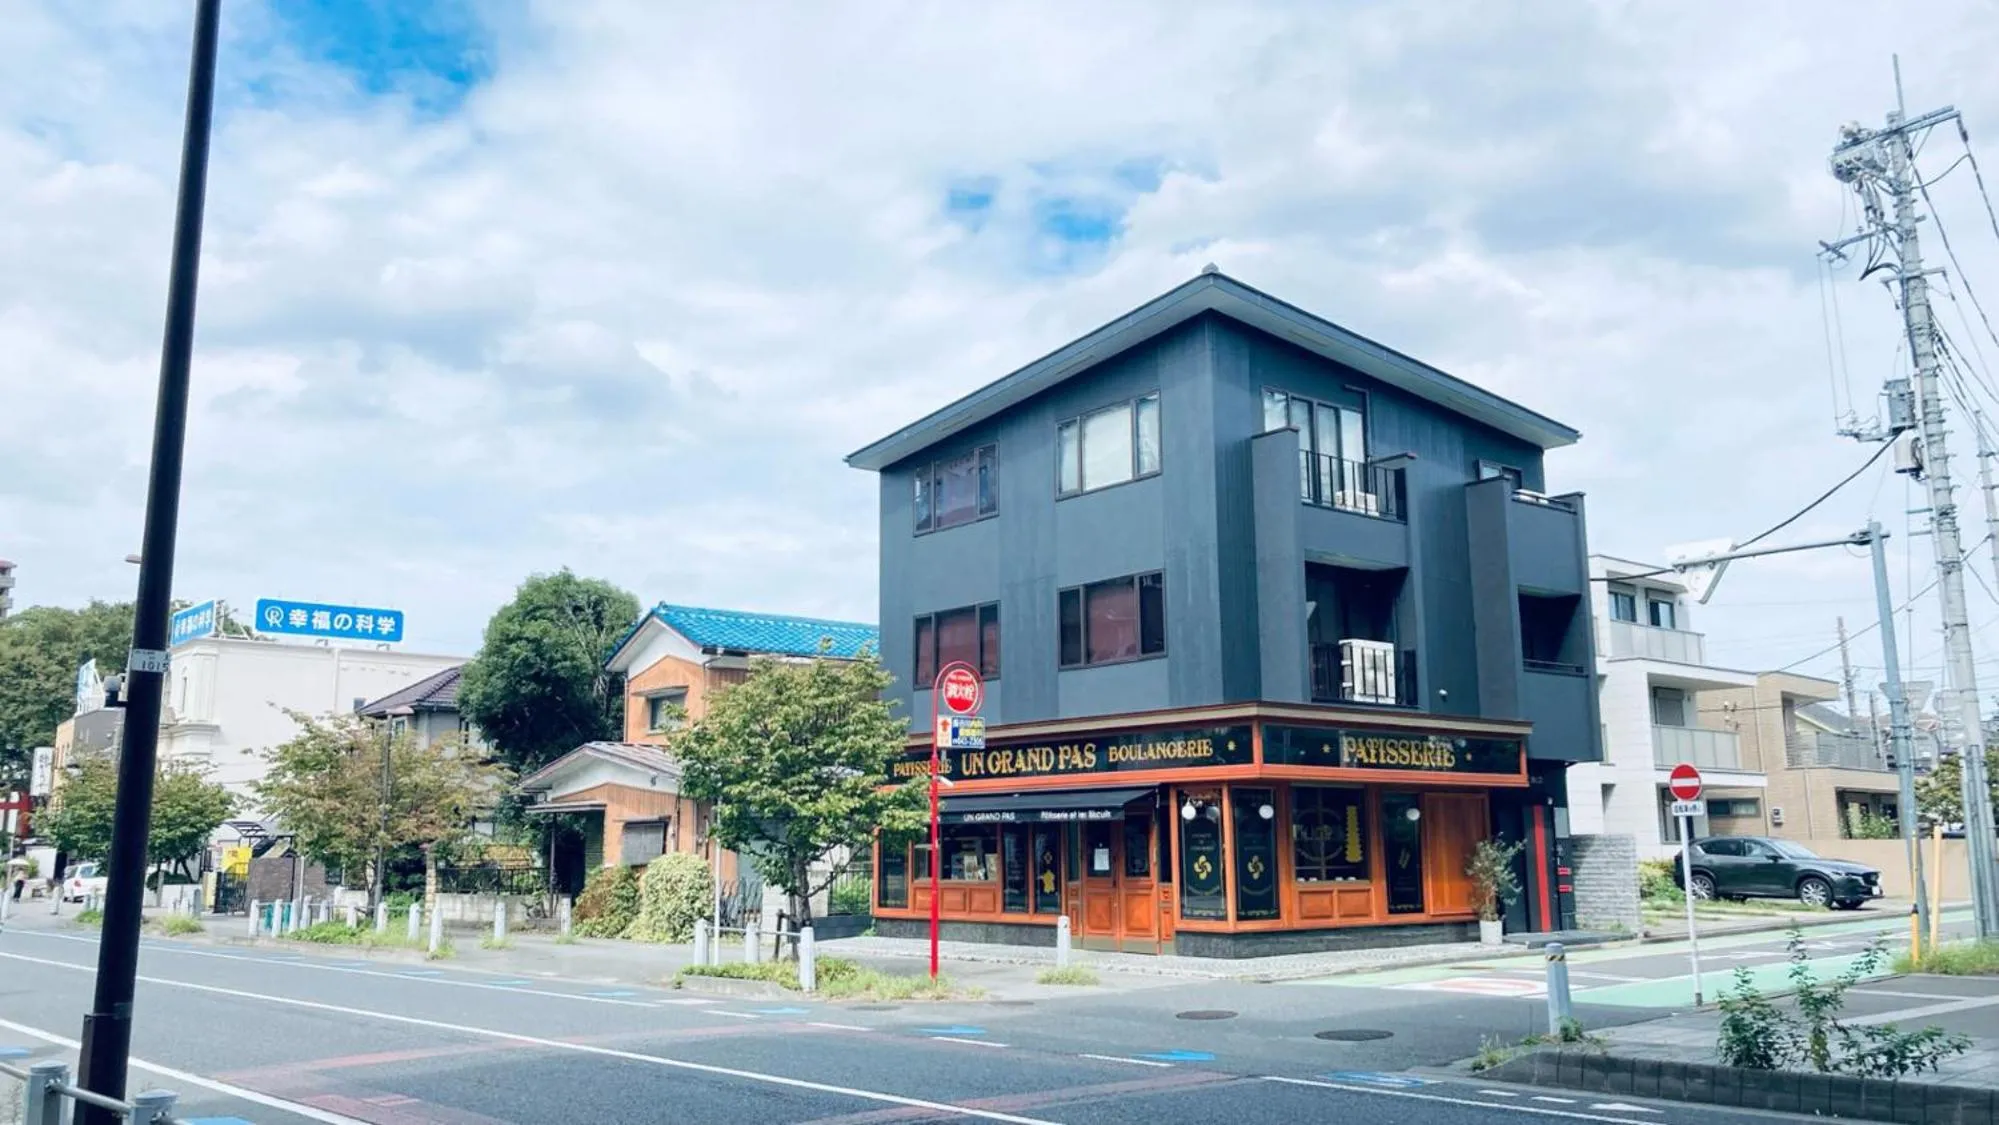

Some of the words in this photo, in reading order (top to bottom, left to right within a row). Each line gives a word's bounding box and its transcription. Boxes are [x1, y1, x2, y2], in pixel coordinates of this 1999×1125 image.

[288, 608, 396, 635] 幸福の科学
[142, 660, 169, 672] 1015
[961, 751, 985, 775] UN
[987, 746, 1055, 773] GRAND
[1058, 743, 1096, 769] PAS
[1108, 738, 1214, 762] BOULANGERIE
[1342, 735, 1456, 767] PATISSERIE
